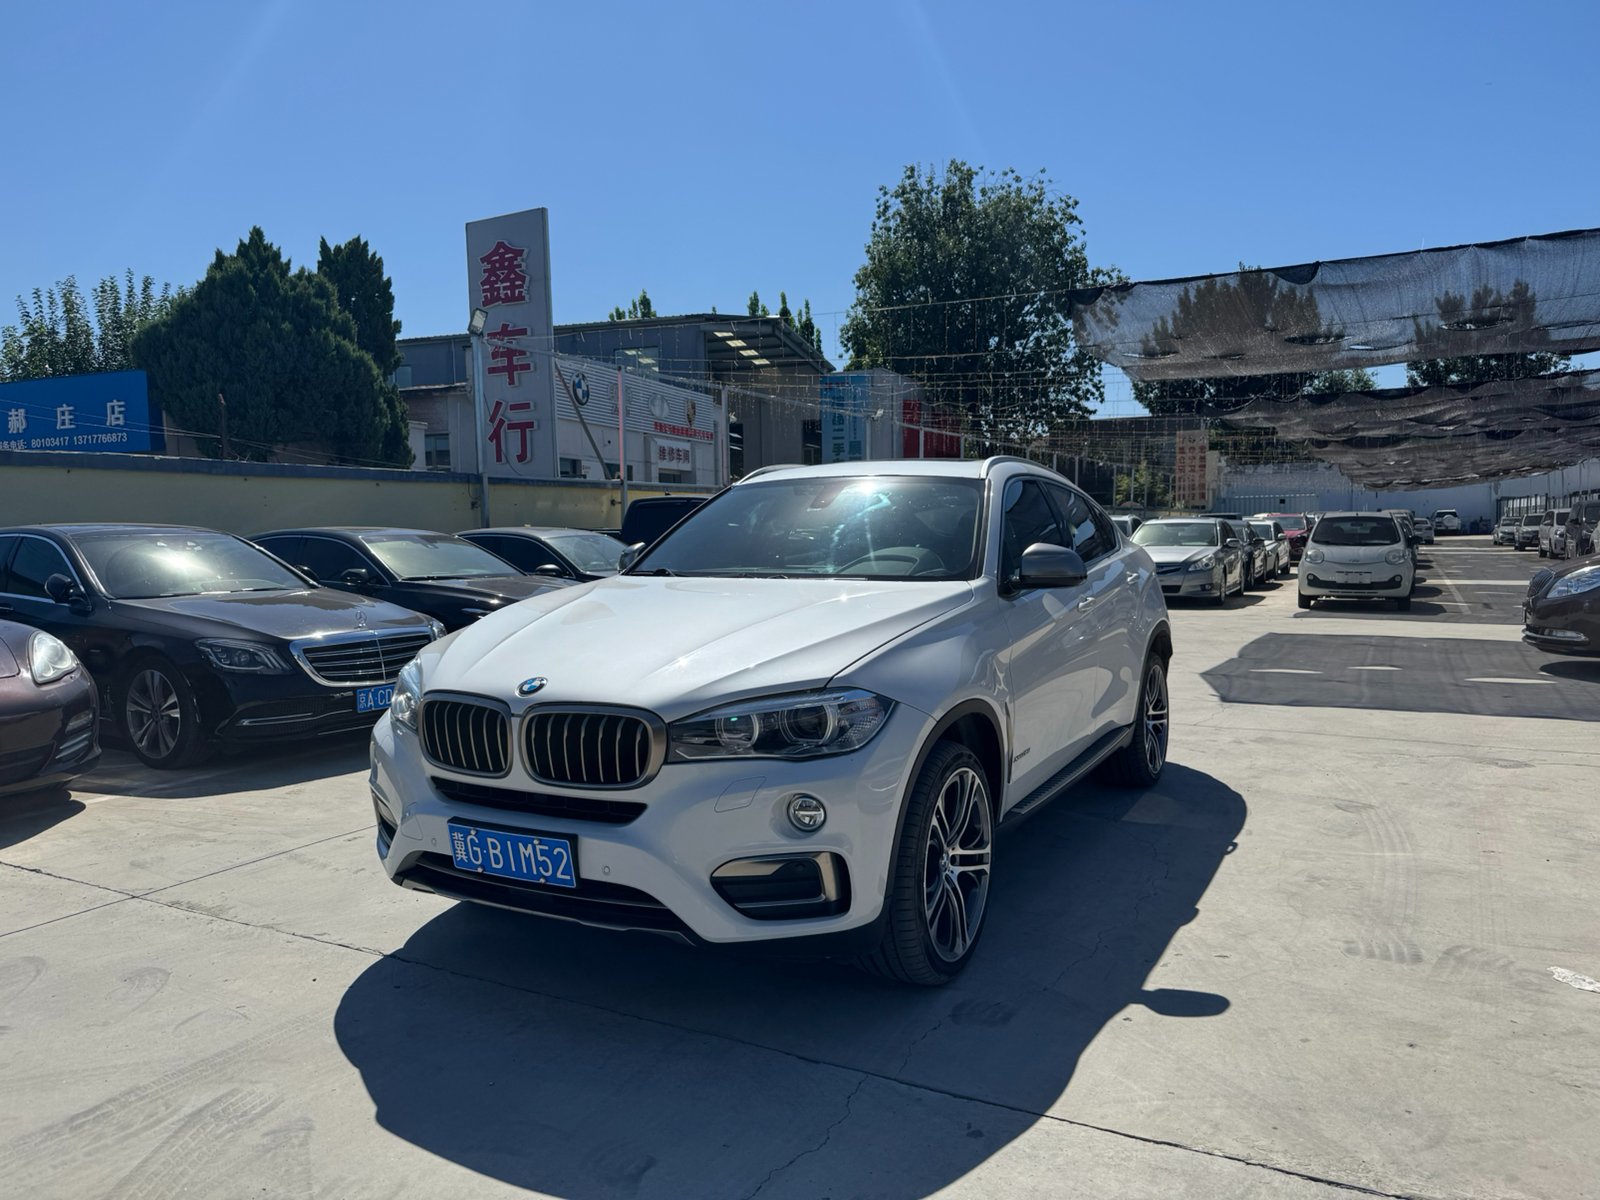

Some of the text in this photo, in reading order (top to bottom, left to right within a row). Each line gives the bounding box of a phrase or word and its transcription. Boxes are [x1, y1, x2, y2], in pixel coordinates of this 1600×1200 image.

[480, 240, 535, 464] 鑫车行
[8, 399, 126, 434] 郝庄店
[31, 436, 69, 448] 80103417
[73, 432, 128, 445] 13717766873
